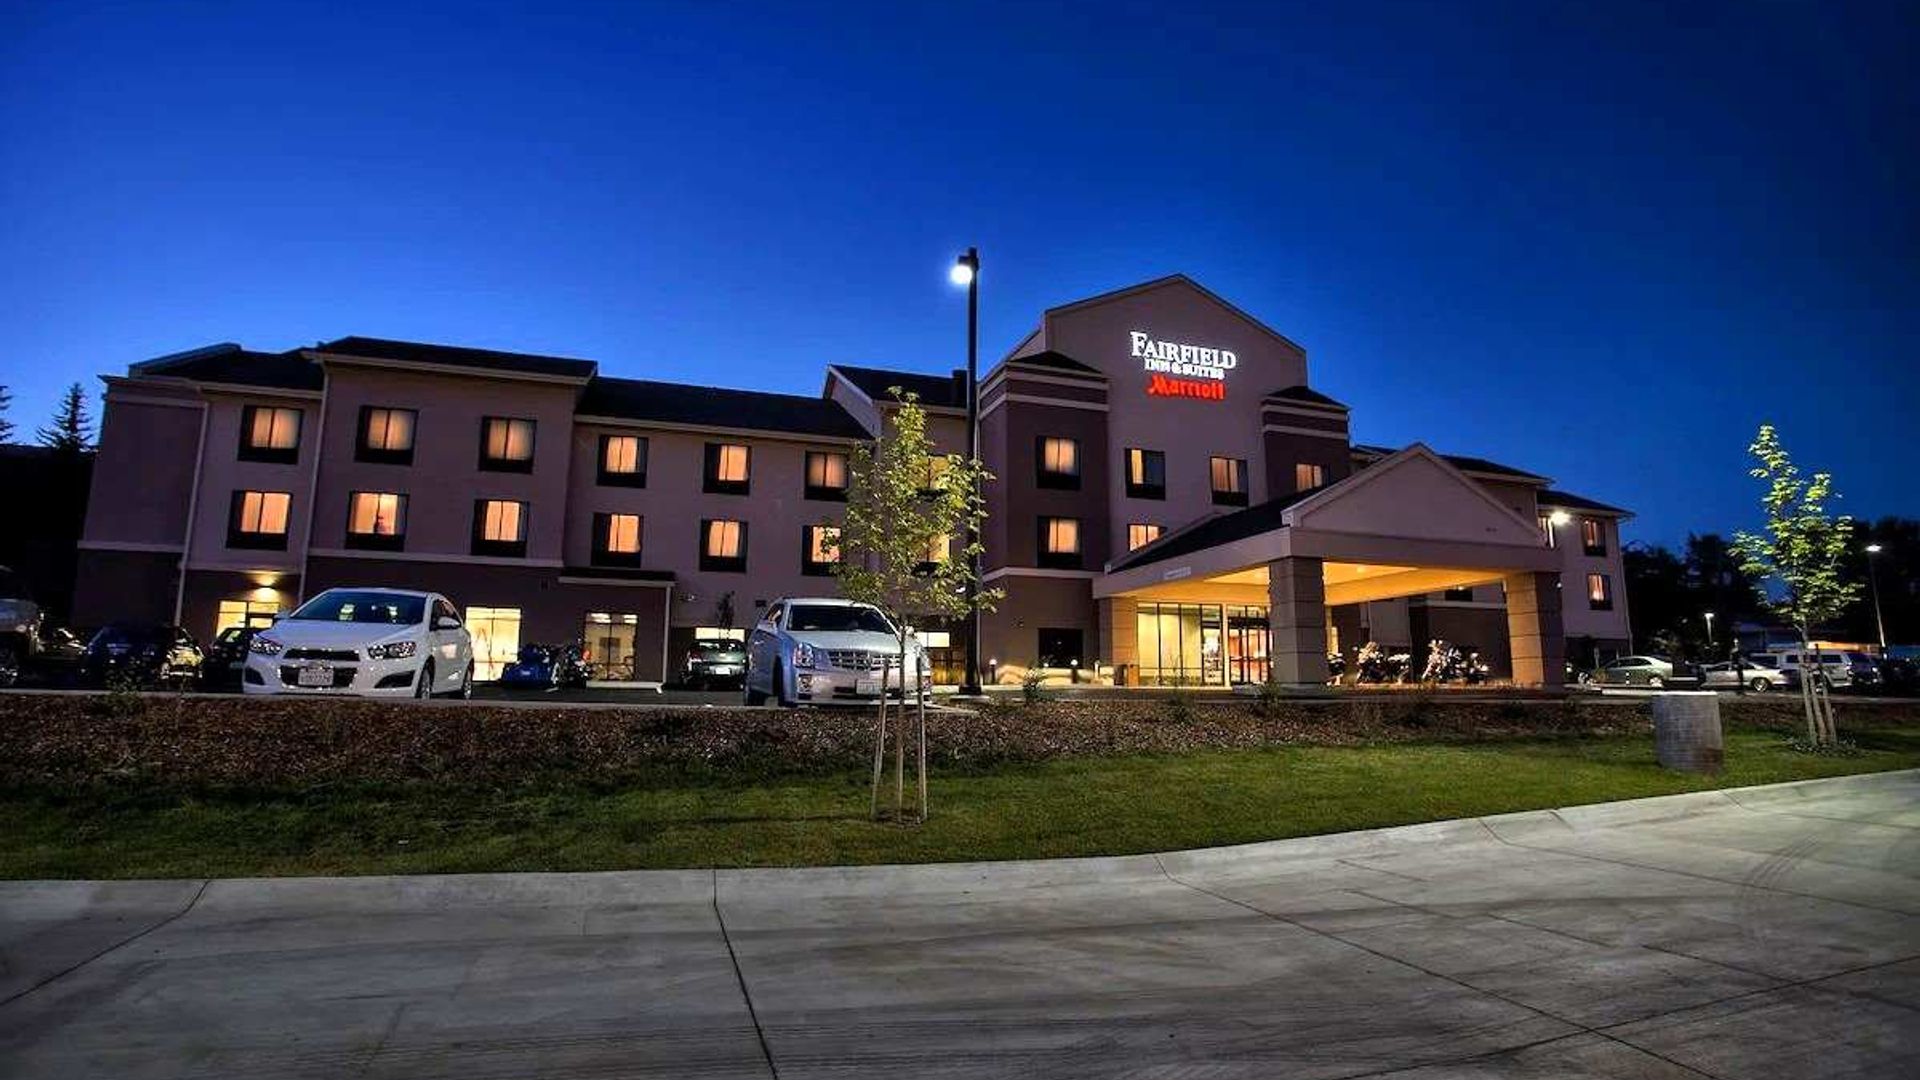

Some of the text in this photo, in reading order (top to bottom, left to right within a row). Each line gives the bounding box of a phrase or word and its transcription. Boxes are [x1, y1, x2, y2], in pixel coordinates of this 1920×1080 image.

[1130, 331, 1236, 370] FAIRFIELD
[1144, 358, 1225, 380] INN & SUITES
[1147, 373, 1226, 400] Marriott
